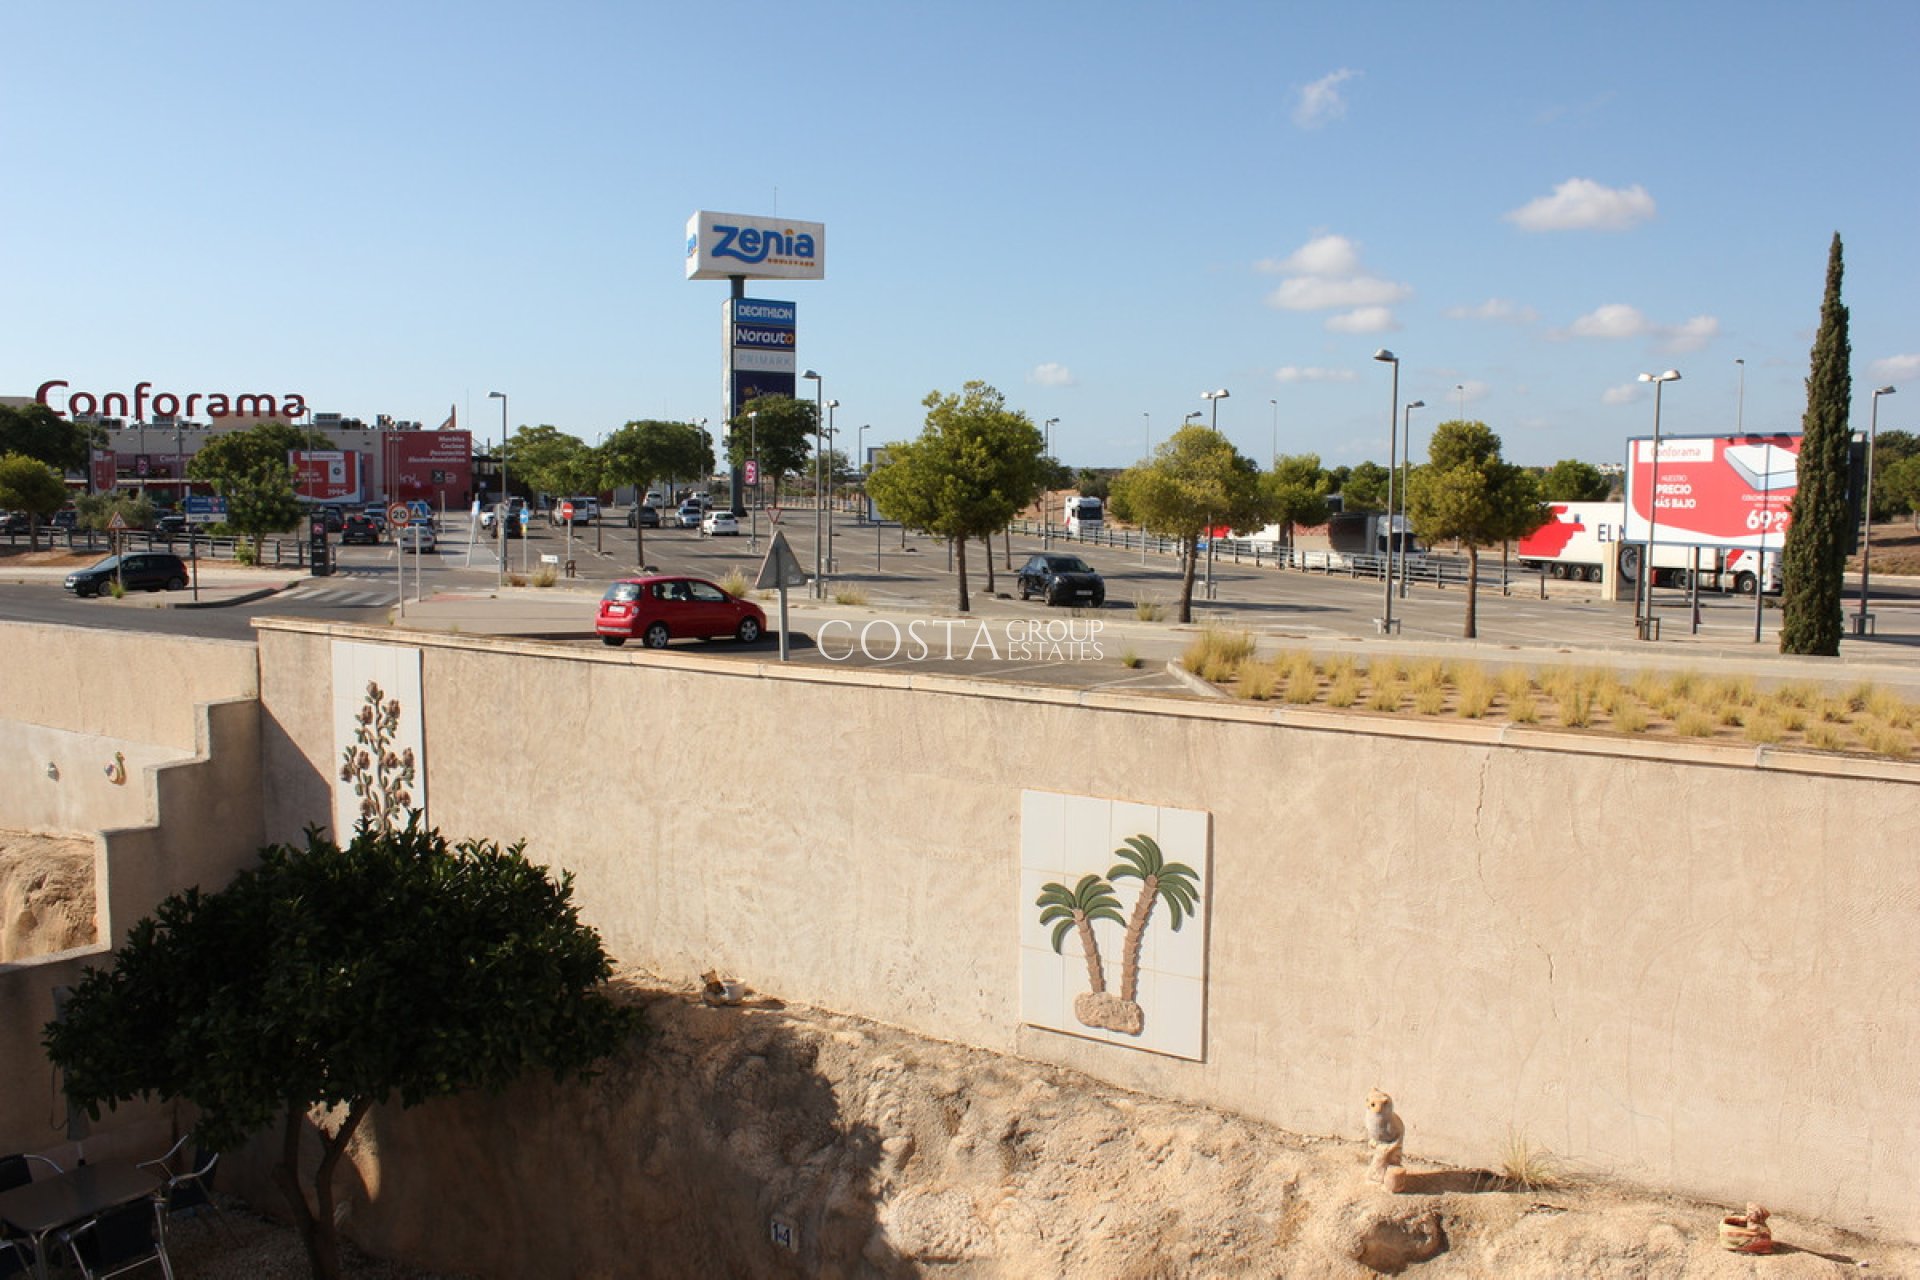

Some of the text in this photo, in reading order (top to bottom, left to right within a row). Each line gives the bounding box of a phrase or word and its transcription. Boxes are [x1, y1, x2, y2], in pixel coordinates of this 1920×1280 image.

[738, 304, 793, 321] DECATHLON
[736, 328, 794, 345] Norauto
[738, 353, 792, 367] PRIMARK
[35, 380, 305, 420] Conforama
[1655, 484, 1692, 495] PRECIO
[1671, 498, 1697, 509] BAJO
[393, 510, 407, 519] 20
[1597, 523, 1616, 543] EL
